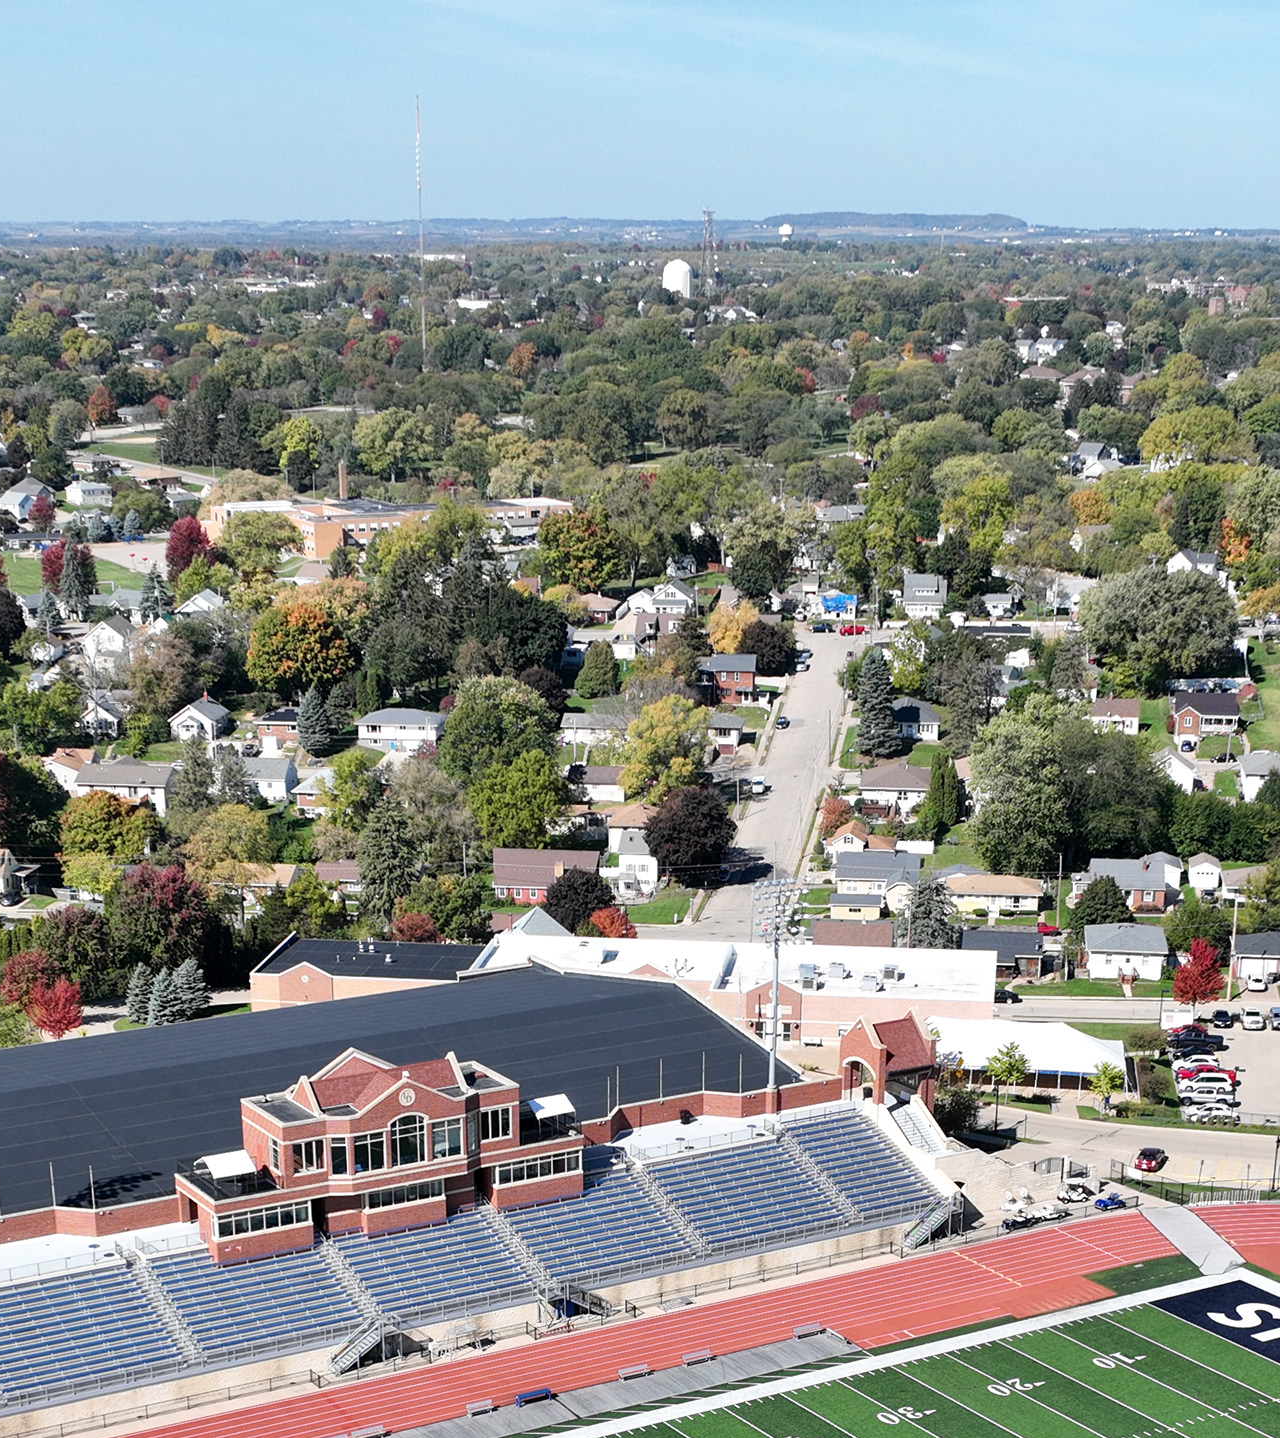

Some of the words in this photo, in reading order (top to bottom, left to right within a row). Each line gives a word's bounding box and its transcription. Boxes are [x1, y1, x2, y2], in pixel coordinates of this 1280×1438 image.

[1092, 1351, 1136, 1369] 10
[987, 1377, 1034, 1397] 20
[877, 1406, 924, 1425] 30
